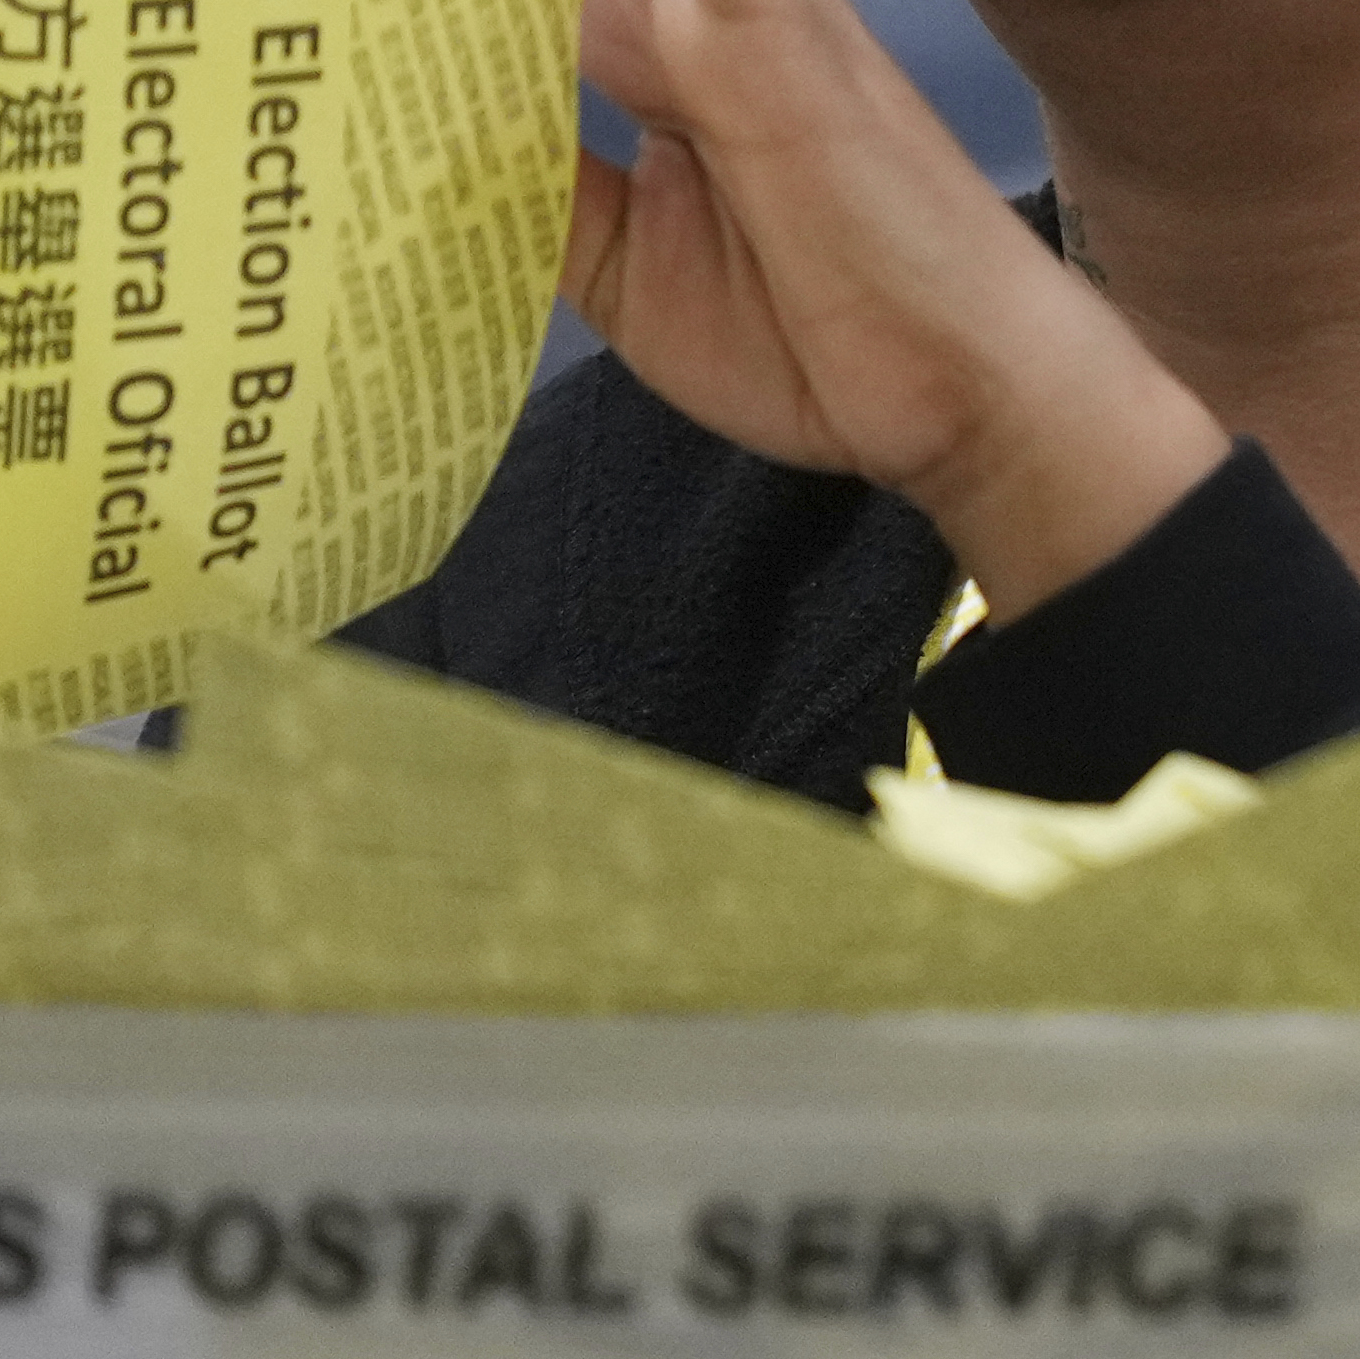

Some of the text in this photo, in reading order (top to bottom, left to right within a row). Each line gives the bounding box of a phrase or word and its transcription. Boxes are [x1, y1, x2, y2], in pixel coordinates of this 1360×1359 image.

[236, 21, 323, 340] Election
[84, 370, 178, 606] Oficial
[199, 361, 297, 573] Ballot
[87, 1186, 635, 1322] POSTAL
[677, 1191, 1315, 1325] SERVICE
